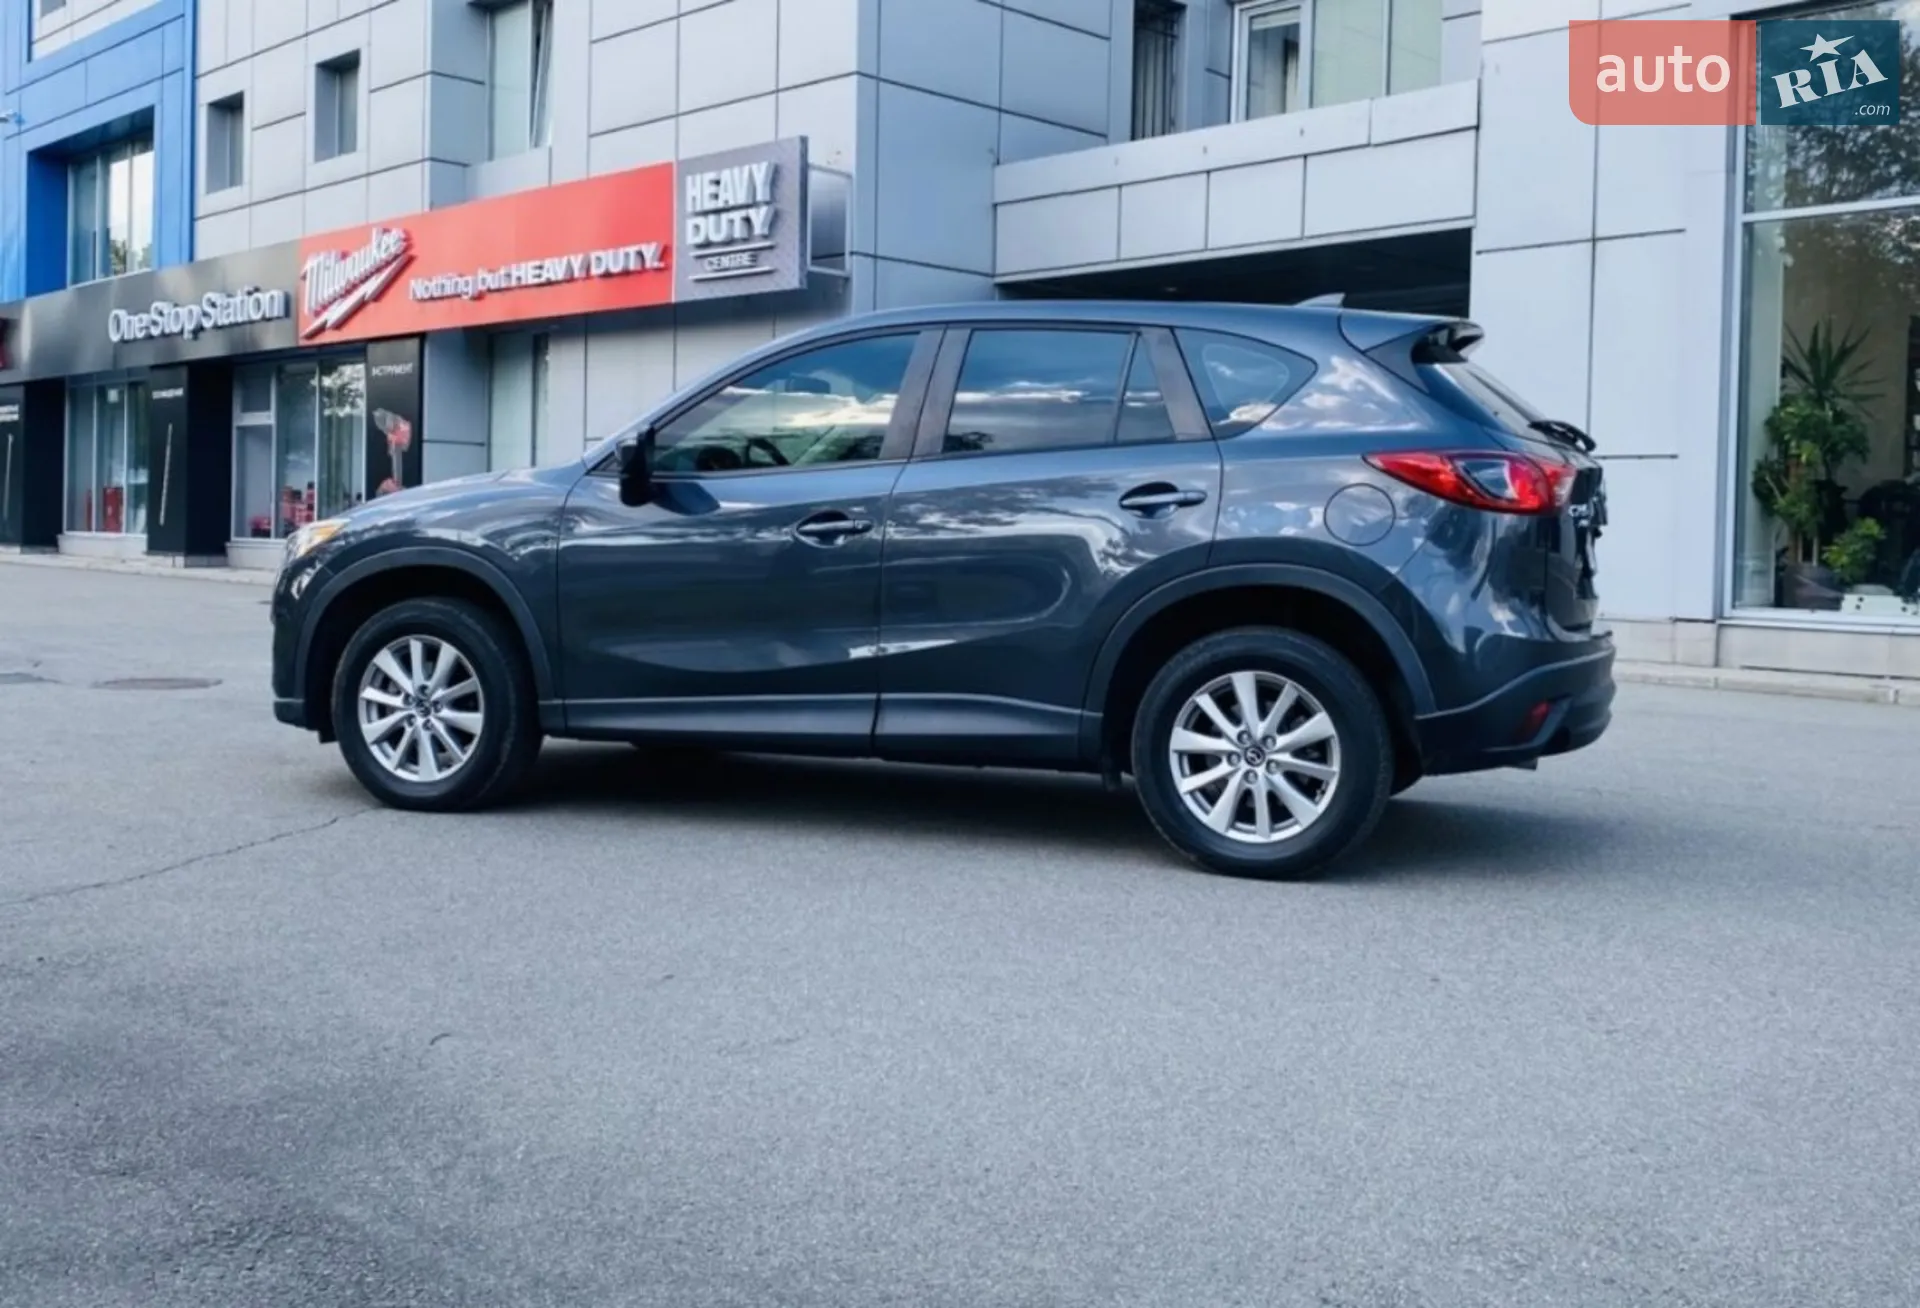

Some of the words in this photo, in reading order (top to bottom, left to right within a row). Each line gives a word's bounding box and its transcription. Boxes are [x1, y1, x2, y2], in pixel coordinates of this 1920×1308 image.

[685, 160, 776, 213] HEAVY
[685, 205, 776, 245] DUTY
[300, 228, 411, 316] Milwaukee
[409, 273, 473, 300] Nothing
[477, 267, 509, 292] but
[511, 253, 587, 286] HEAVY
[200, 285, 288, 329] Station
